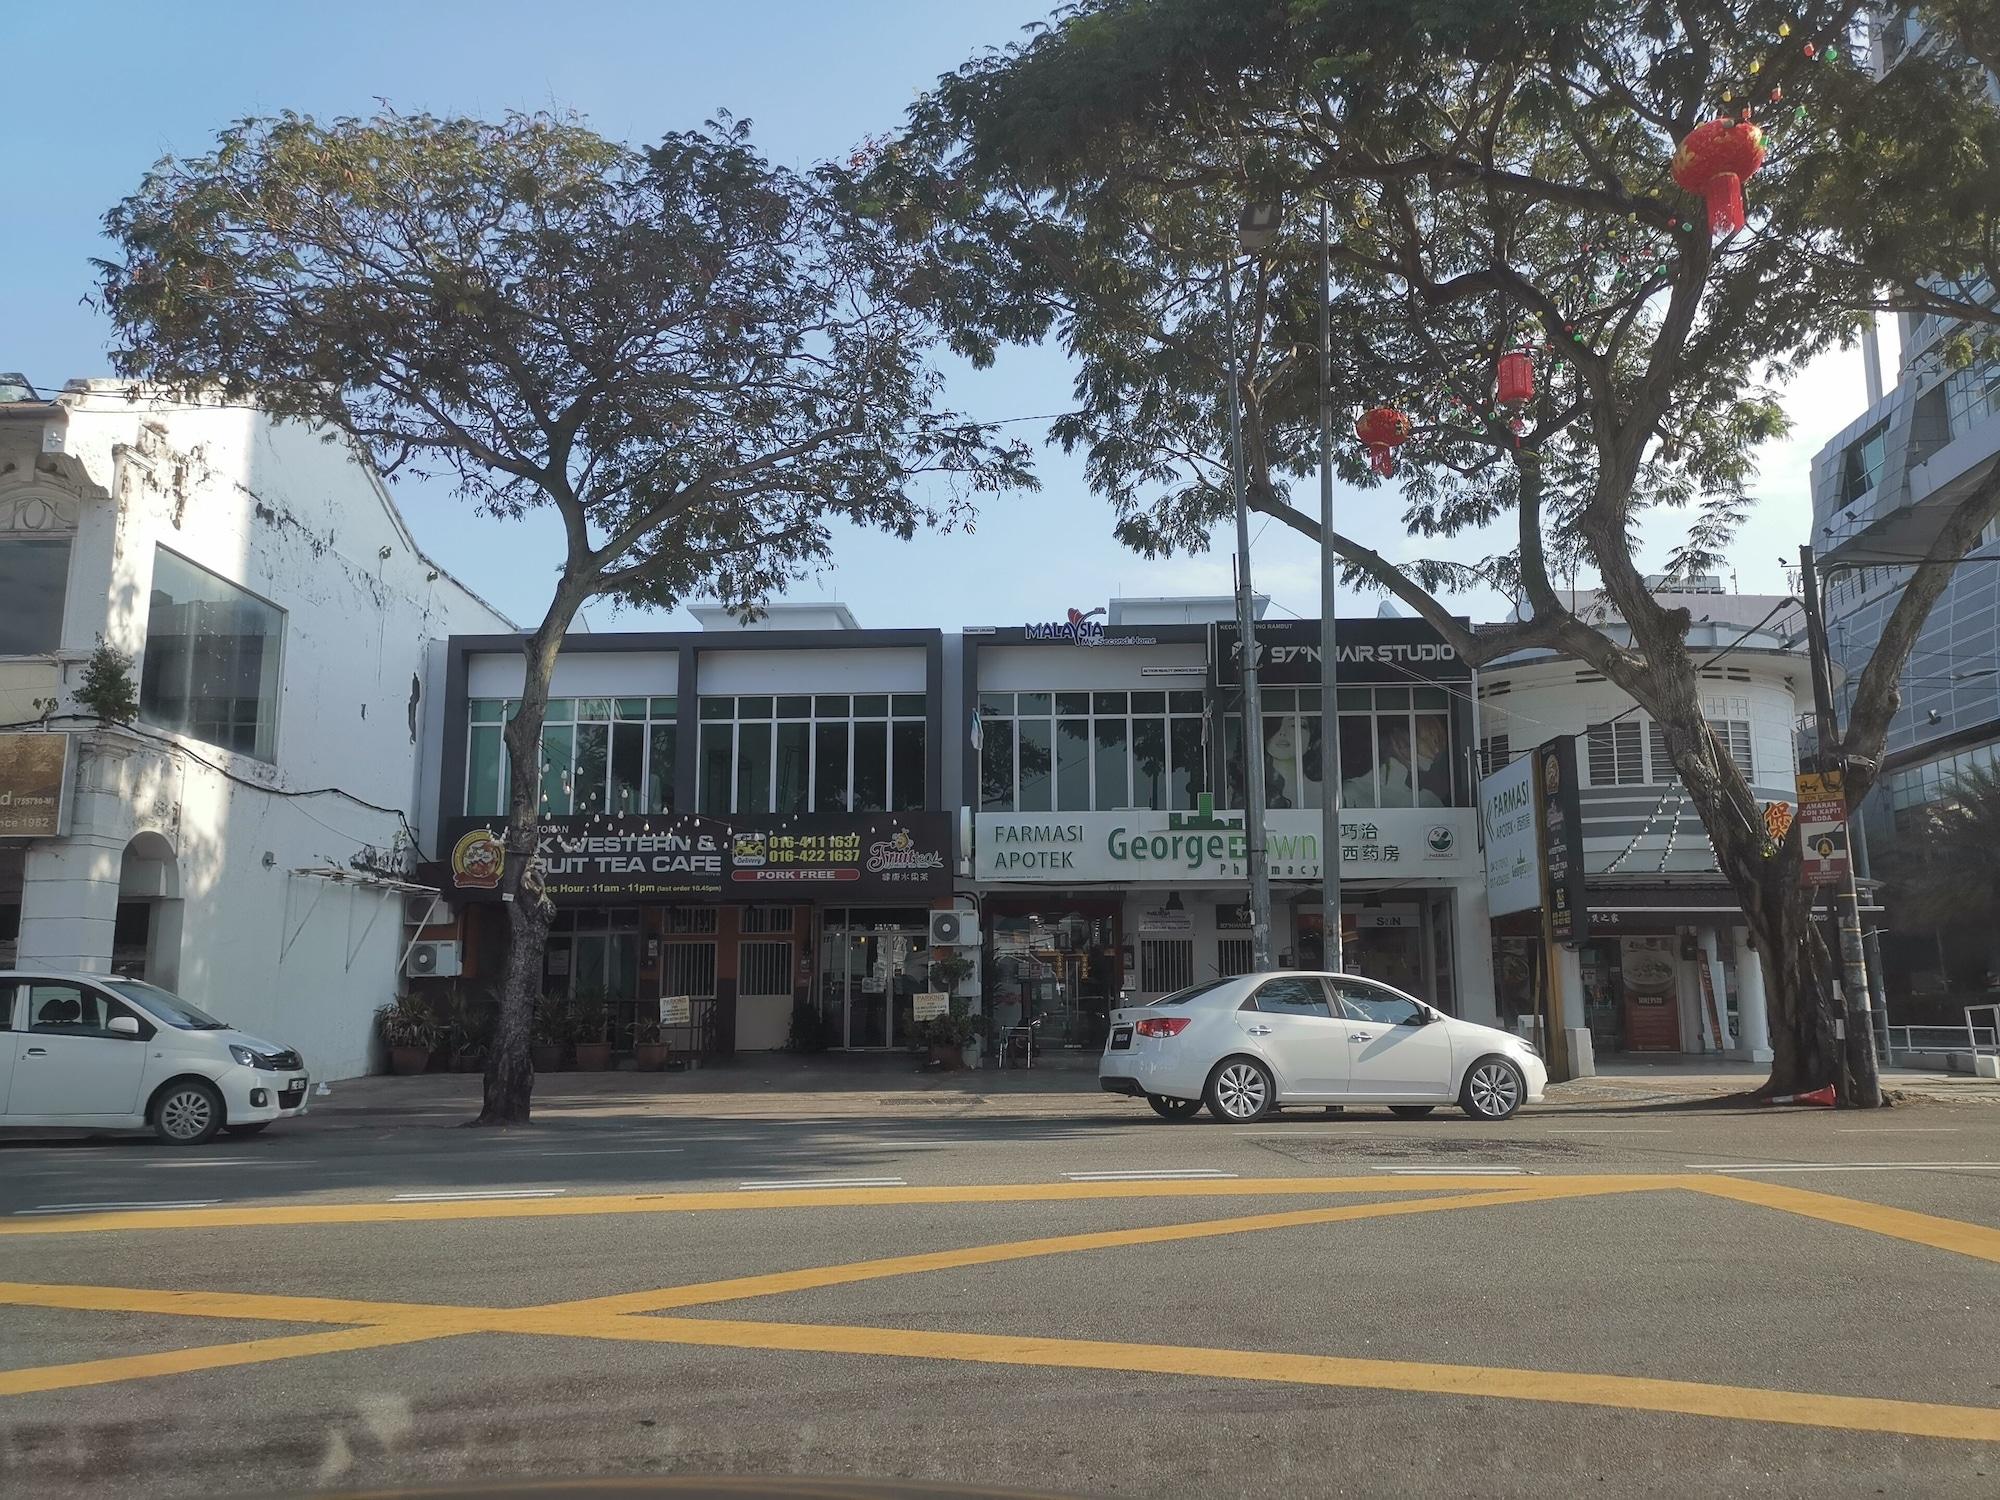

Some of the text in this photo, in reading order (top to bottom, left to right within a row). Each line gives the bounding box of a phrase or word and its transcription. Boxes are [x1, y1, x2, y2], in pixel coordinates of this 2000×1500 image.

[1025, 621, 1104, 646] MALAYSIA
[1082, 636, 1157, 647] My Second Home
[1377, 643, 1457, 662] STUDIO
[1493, 780, 1530, 818] FARMASI
[1806, 801, 1837, 809] AMARAN
[1801, 807, 1841, 817] ZON KAPIT
[829, 835, 860, 849] 1637
[994, 825, 1084, 844] FARMASI
[538, 833, 717, 854] K WESTERN &
[769, 849, 860, 863] 016-422 1637
[995, 851, 1074, 868] APOTEK
[1342, 845, 1400, 861] 西药房
[533, 854, 721, 873] RUIT TEA CAFE
[1220, 861, 1321, 877] Phmacy
[756, 870, 836, 880] PORK FREE
[560, 884, 585, 893] Hour
[591, 883, 621, 893] 11am
[628, 883, 655, 894] 11pm
[657, 885, 672, 893] (last
